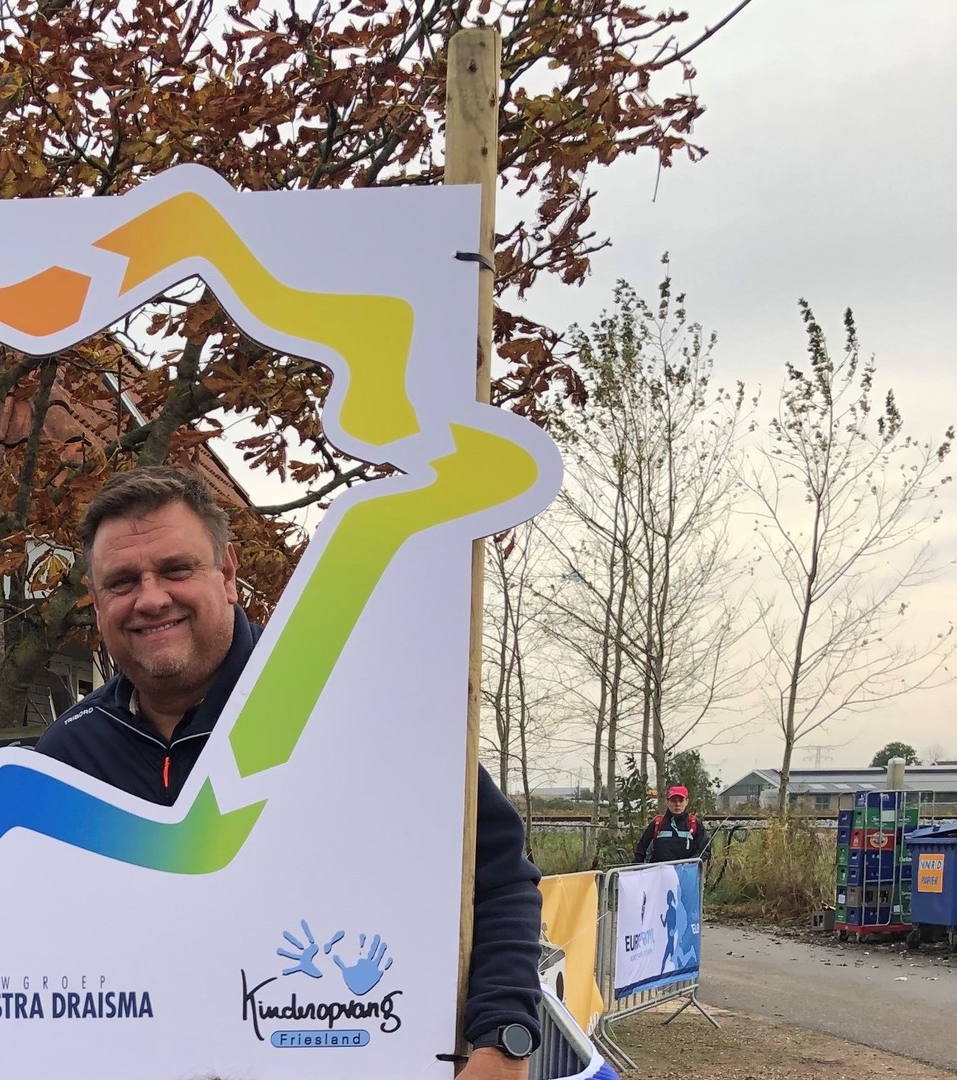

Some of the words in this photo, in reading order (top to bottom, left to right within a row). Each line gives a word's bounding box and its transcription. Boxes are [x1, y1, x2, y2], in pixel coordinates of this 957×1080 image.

[64, 707, 94, 726] TRIBORD
[52, 991, 154, 1019] DRAISMA
[241, 968, 403, 1041] Kinderopvang
[279, 1032, 361, 1046] Friesland
